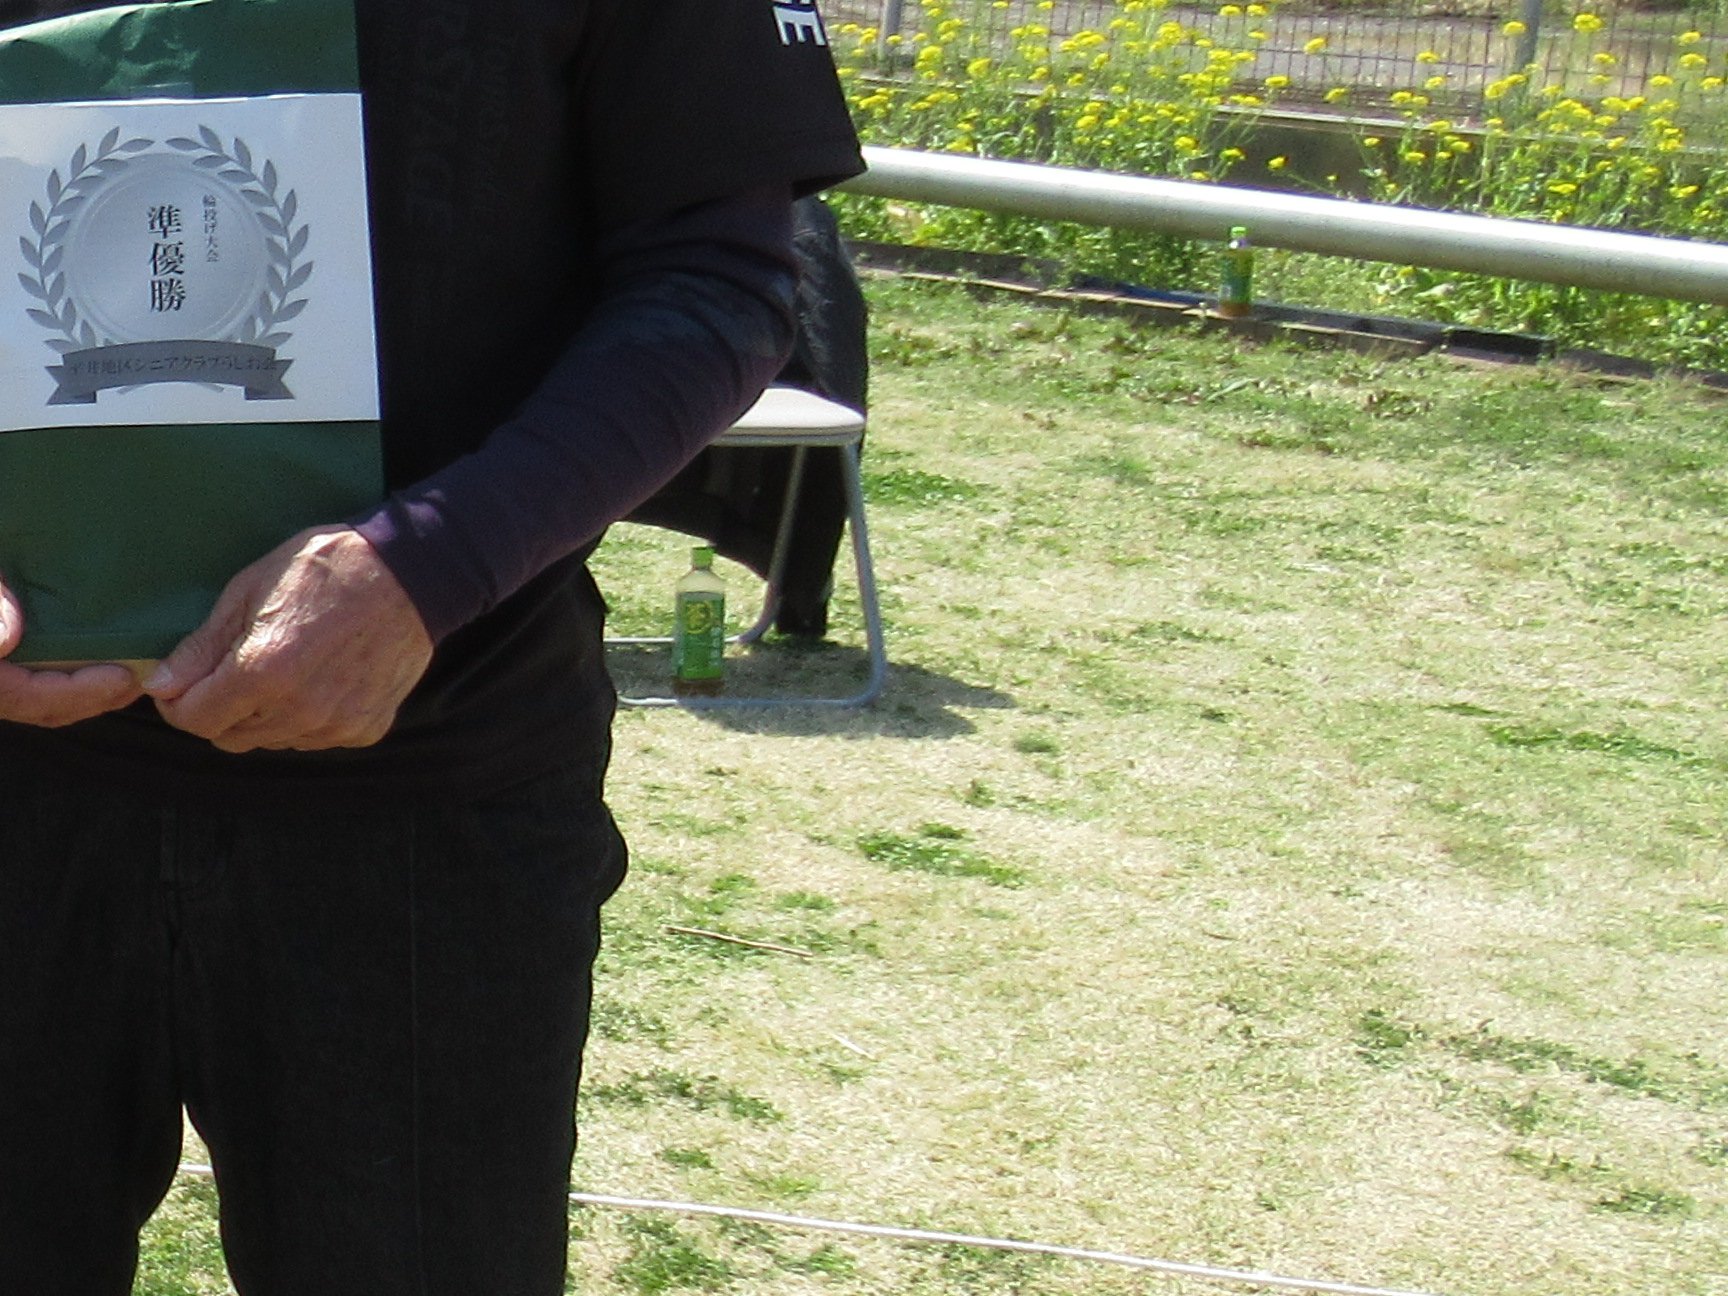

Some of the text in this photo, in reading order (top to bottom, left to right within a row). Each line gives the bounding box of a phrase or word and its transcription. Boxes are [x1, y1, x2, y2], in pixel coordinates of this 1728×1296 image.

[147, 204, 187, 313] 準優勝
[203, 195, 219, 262] 輪投げ大会
